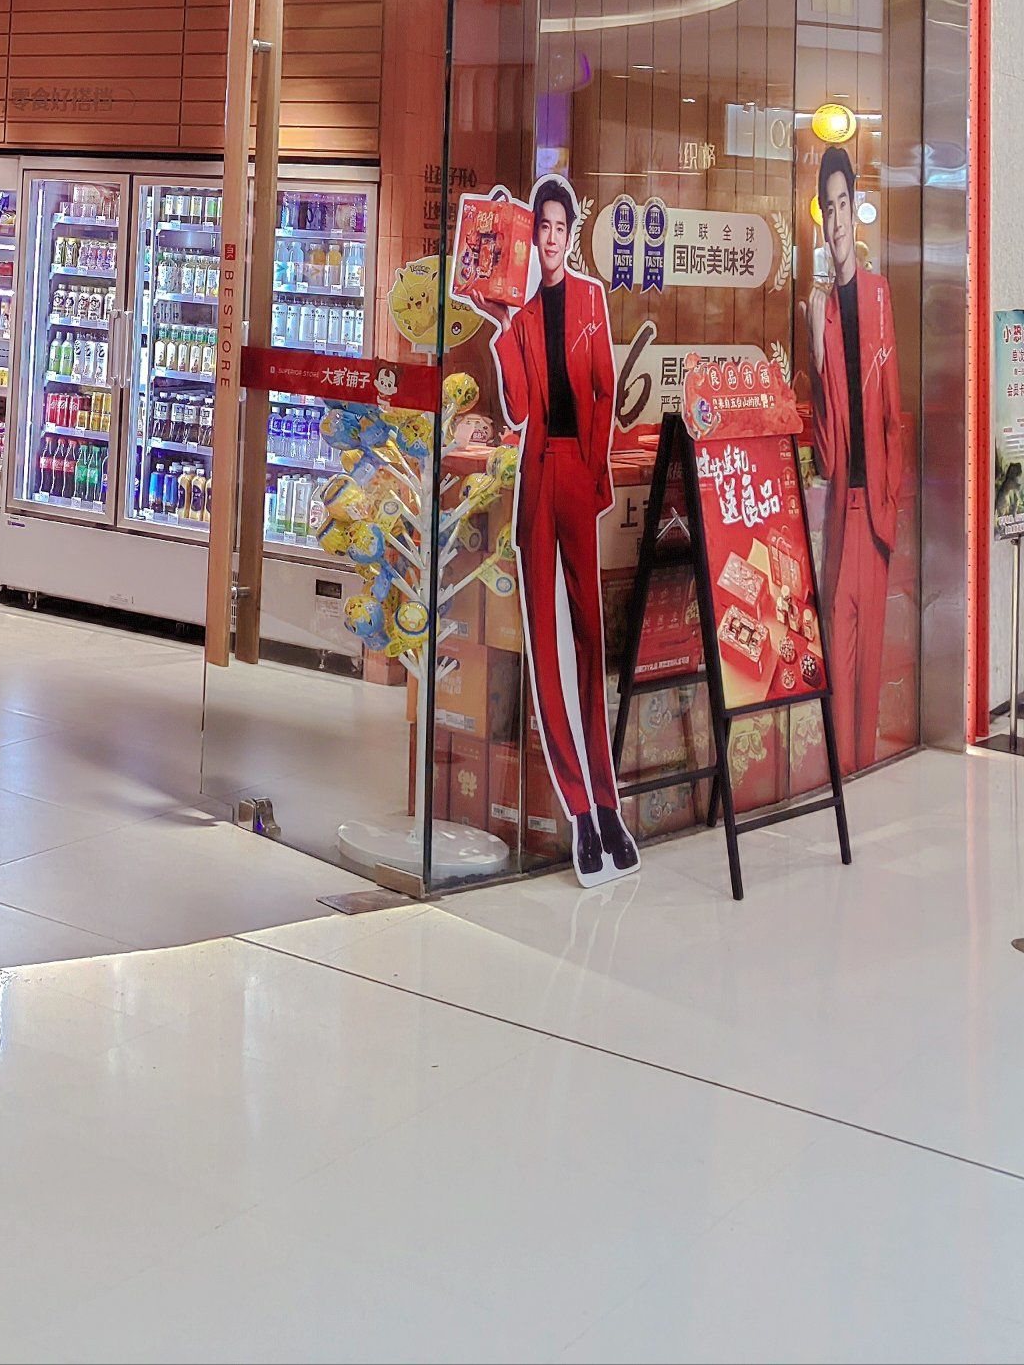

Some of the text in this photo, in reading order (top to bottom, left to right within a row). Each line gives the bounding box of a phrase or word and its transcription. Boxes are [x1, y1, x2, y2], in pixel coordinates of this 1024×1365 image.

[614, 254, 633, 268] TASTE
[645, 255, 664, 268] TASTE
[673, 244, 755, 276] 国际美味奖
[220, 270, 235, 389] BESTORE
[321, 367, 371, 389] 大家铺子
